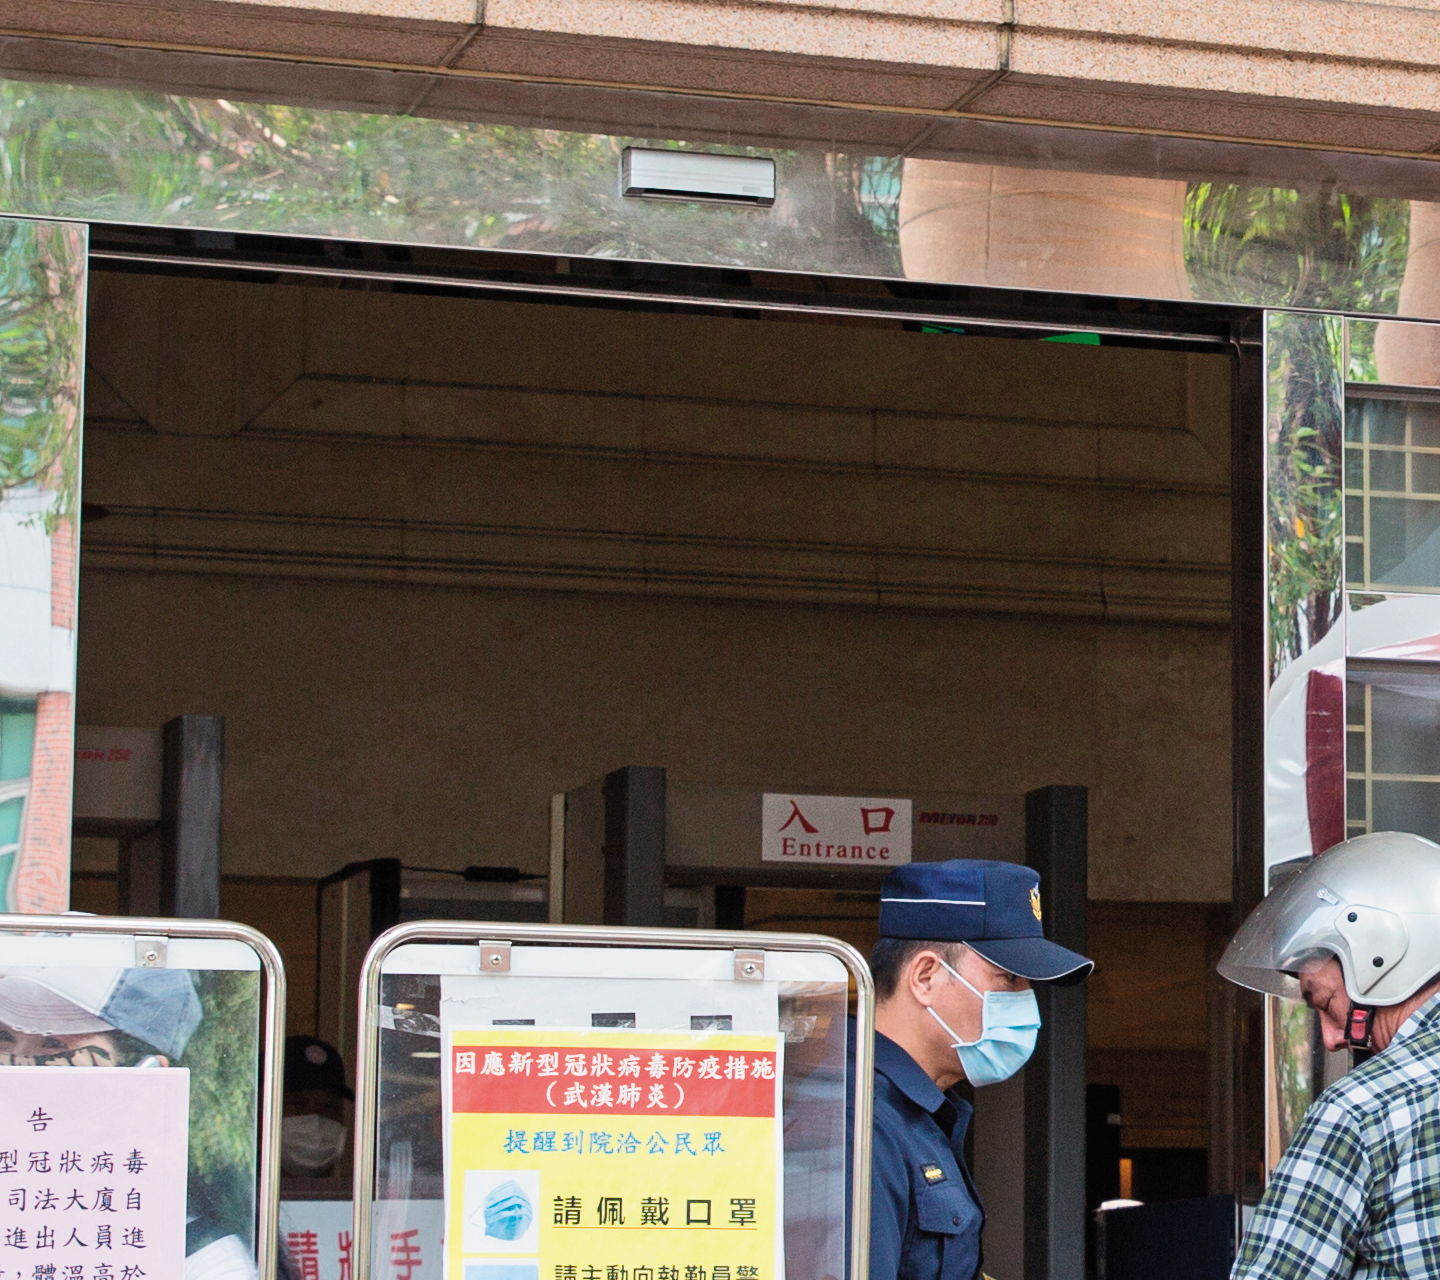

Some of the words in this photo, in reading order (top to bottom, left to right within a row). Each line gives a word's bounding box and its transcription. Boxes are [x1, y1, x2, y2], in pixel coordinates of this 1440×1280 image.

[777, 799, 896, 836] 入口
[781, 837, 890, 860] Entrance
[454, 1050, 776, 1081] 因應新型冠狀病毒防疫措施
[503, 1129, 727, 1157] 提醒到院洽公民眾
[553, 1195, 759, 1227] 請佩戴口罩
